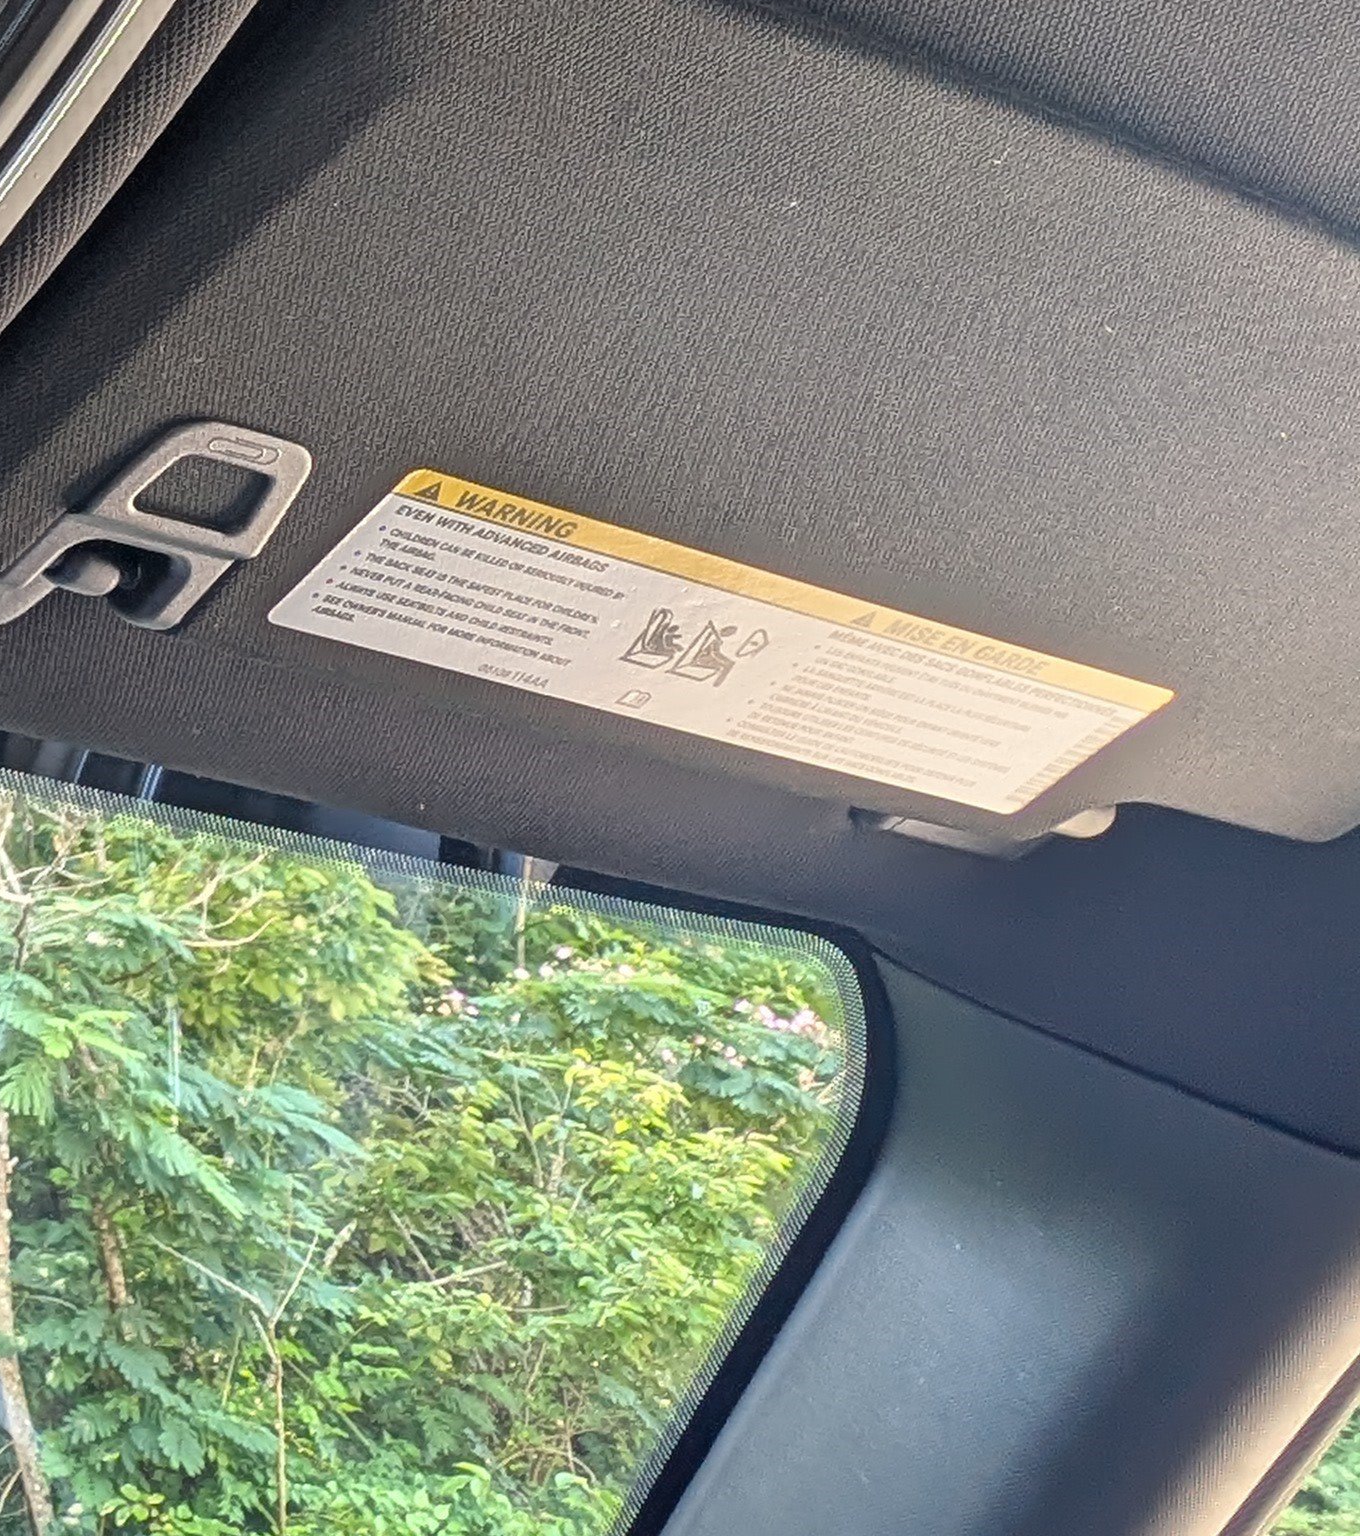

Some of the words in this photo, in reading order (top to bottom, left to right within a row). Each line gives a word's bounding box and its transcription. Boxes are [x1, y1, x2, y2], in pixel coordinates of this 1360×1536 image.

[376, 537, 402, 551] THE
[393, 504, 437, 524] EVEN
[432, 515, 476, 534] WITH
[470, 526, 552, 556] ADVANCED
[546, 547, 612, 573] AIRBAGS
[451, 490, 582, 540] WARNING
[362, 552, 388, 565] THE
[382, 557, 413, 572] BACK
[409, 565, 438, 579] SEAT
[433, 571, 450, 582] IS
[445, 575, 469, 587] THE
[465, 580, 504, 597] SAFEST
[500, 590, 535, 605] PLACE
[529, 598, 555, 611] FOR
[386, 527, 441, 548] CHILDREN
[437, 541, 462, 554] CAN
[459, 547, 477, 558] BE
[472, 551, 511, 567] KILLED
[505, 560, 526, 572] OR
[522, 565, 577, 586] SERIOUSLY
[571, 579, 616, 597] INJURED
[333, 580, 377, 597] ALWAYS
[373, 590, 398, 603] USE
[394, 596, 449, 616] SEATBELTS
[444, 610, 471, 622] AND
[466, 615, 499, 630] CHILD
[348, 566, 386, 582] NEVER
[381, 575, 408, 588] PUT
[401, 580, 415, 590] A
[410, 583, 477, 607] REAR-FACING
[472, 599, 506, 614] CHILD
[500, 607, 529, 621] SEAT
[525, 614, 541, 624] IN
[536, 617, 561, 629] THE
[320, 593, 344, 606] SEE
[340, 599, 389, 618] OWNER'S
[384, 610, 429, 628] MANUAL
[424, 621, 450, 634] FOR
[445, 627, 478, 641] MORE
[473, 634, 542, 658] INFORMATION
[537, 651, 573, 666] ABOUT
[881, 618, 947, 646] MISE
[936, 634, 978, 655] EN
[969, 643, 1051, 676] GARDE
